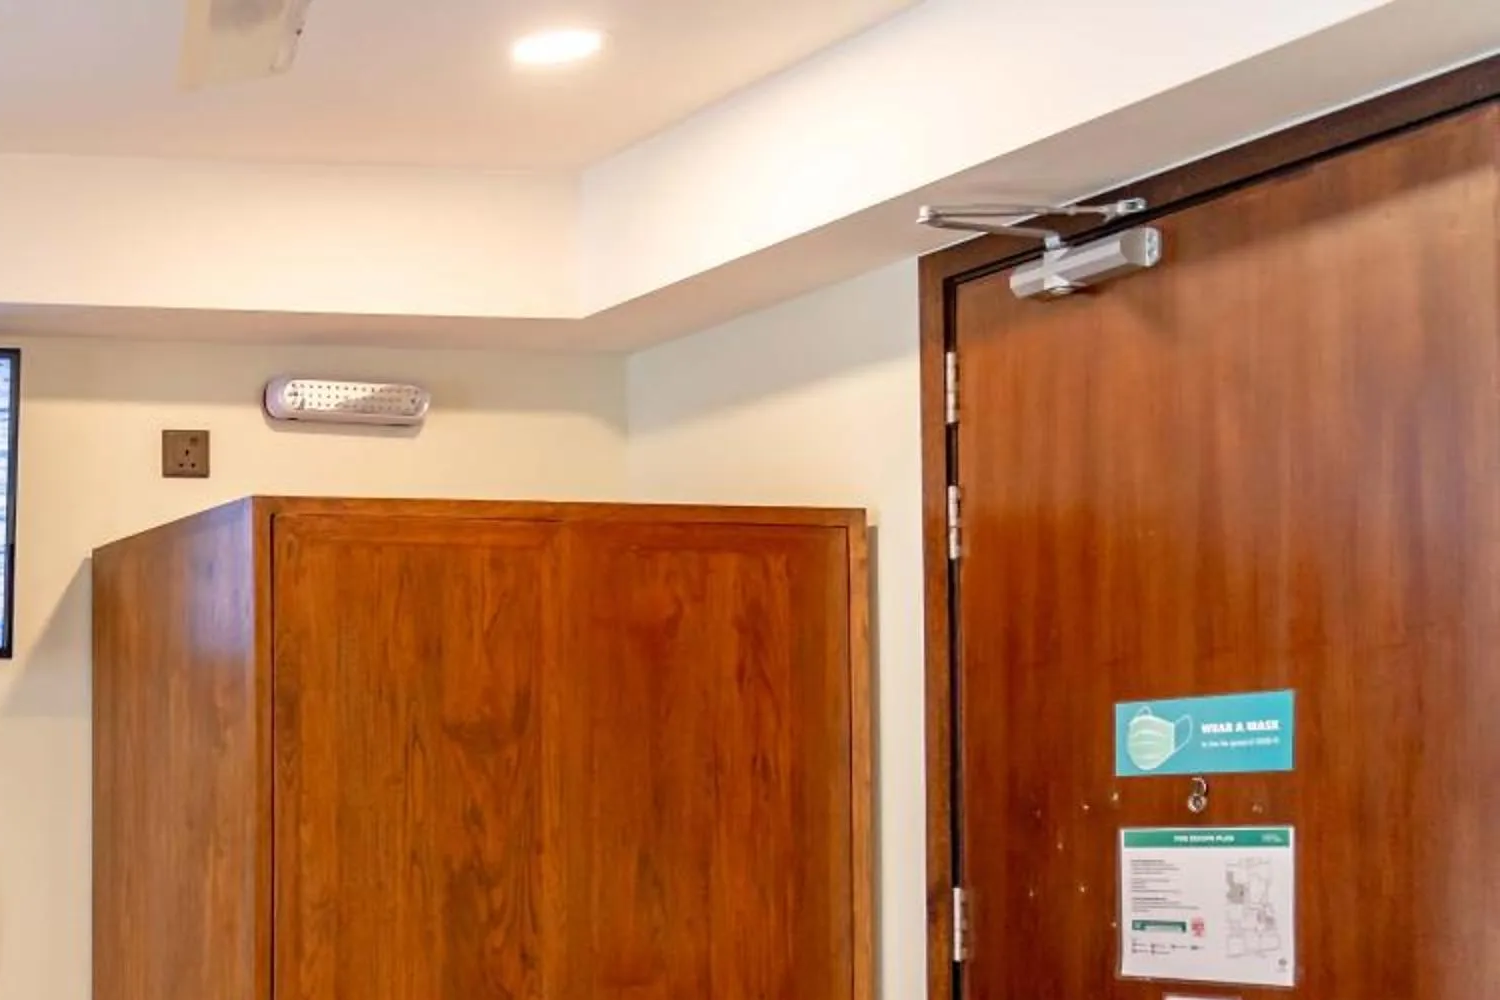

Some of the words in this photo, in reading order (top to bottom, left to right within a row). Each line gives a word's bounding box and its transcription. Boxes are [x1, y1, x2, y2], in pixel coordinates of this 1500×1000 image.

[1202, 723, 1232, 733] WEAR
[1236, 722, 1244, 732] A
[1246, 720, 1279, 731] MASK
